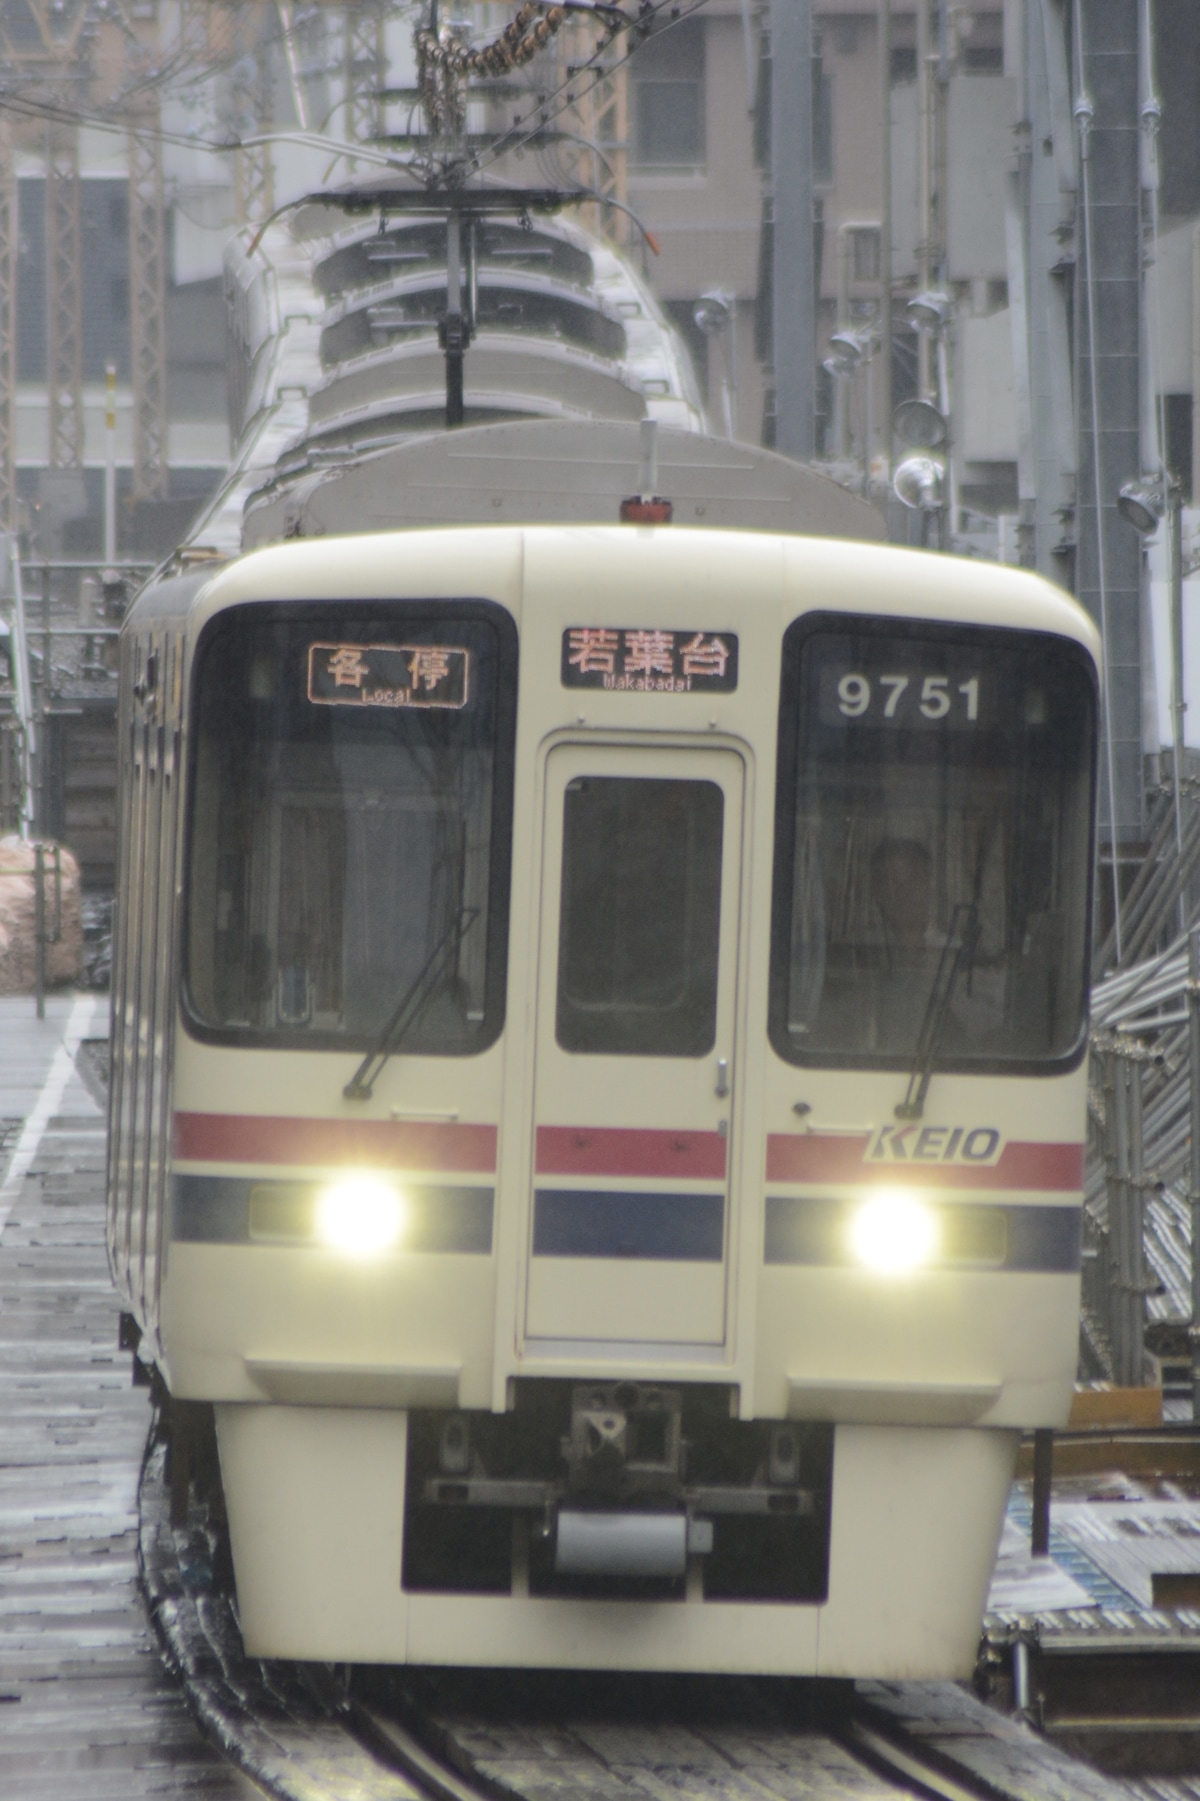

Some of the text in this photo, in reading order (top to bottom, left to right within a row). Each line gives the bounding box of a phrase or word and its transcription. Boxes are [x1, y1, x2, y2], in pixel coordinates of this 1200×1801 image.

[569, 628, 729, 676] 若葉台
[362, 688, 411, 703] Local
[603, 672, 692, 692] Wakabadai
[838, 674, 979, 720] 9751
[871, 1125, 1000, 1160] KEIO
